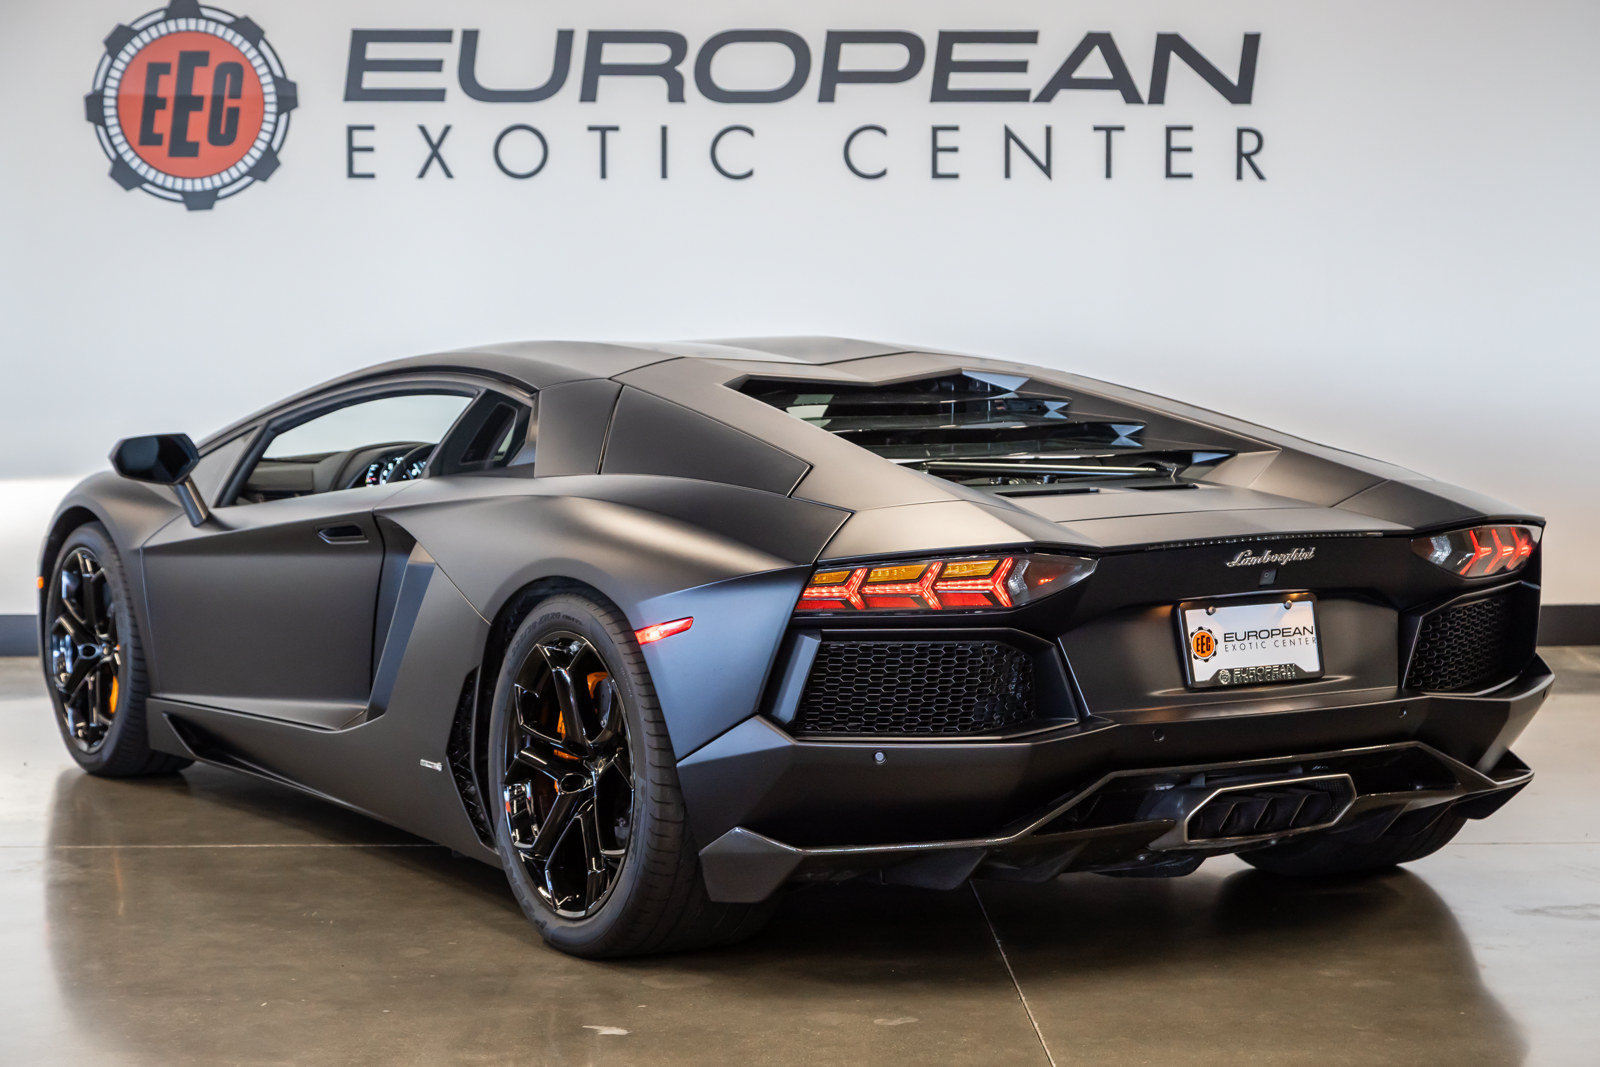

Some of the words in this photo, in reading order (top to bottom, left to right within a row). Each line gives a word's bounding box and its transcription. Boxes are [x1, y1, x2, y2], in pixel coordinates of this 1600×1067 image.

[343, 28, 1261, 105] EUROPEAN
[138, 50, 245, 158] EEC
[346, 123, 755, 180] EXOTIC
[843, 123, 1266, 181] CENTER
[1226, 547, 1316, 567] Lamborghini
[1224, 626, 1314, 643] EUROPEAN
[1197, 635, 1211, 654] EEC
[1224, 641, 1267, 652] EXOTIC
[1273, 637, 1317, 648] CENTER
[1233, 664, 1296, 677] EUROPEAN
[1233, 675, 1264, 684] EXOTIC
[1266, 671, 1297, 681] CENTER
